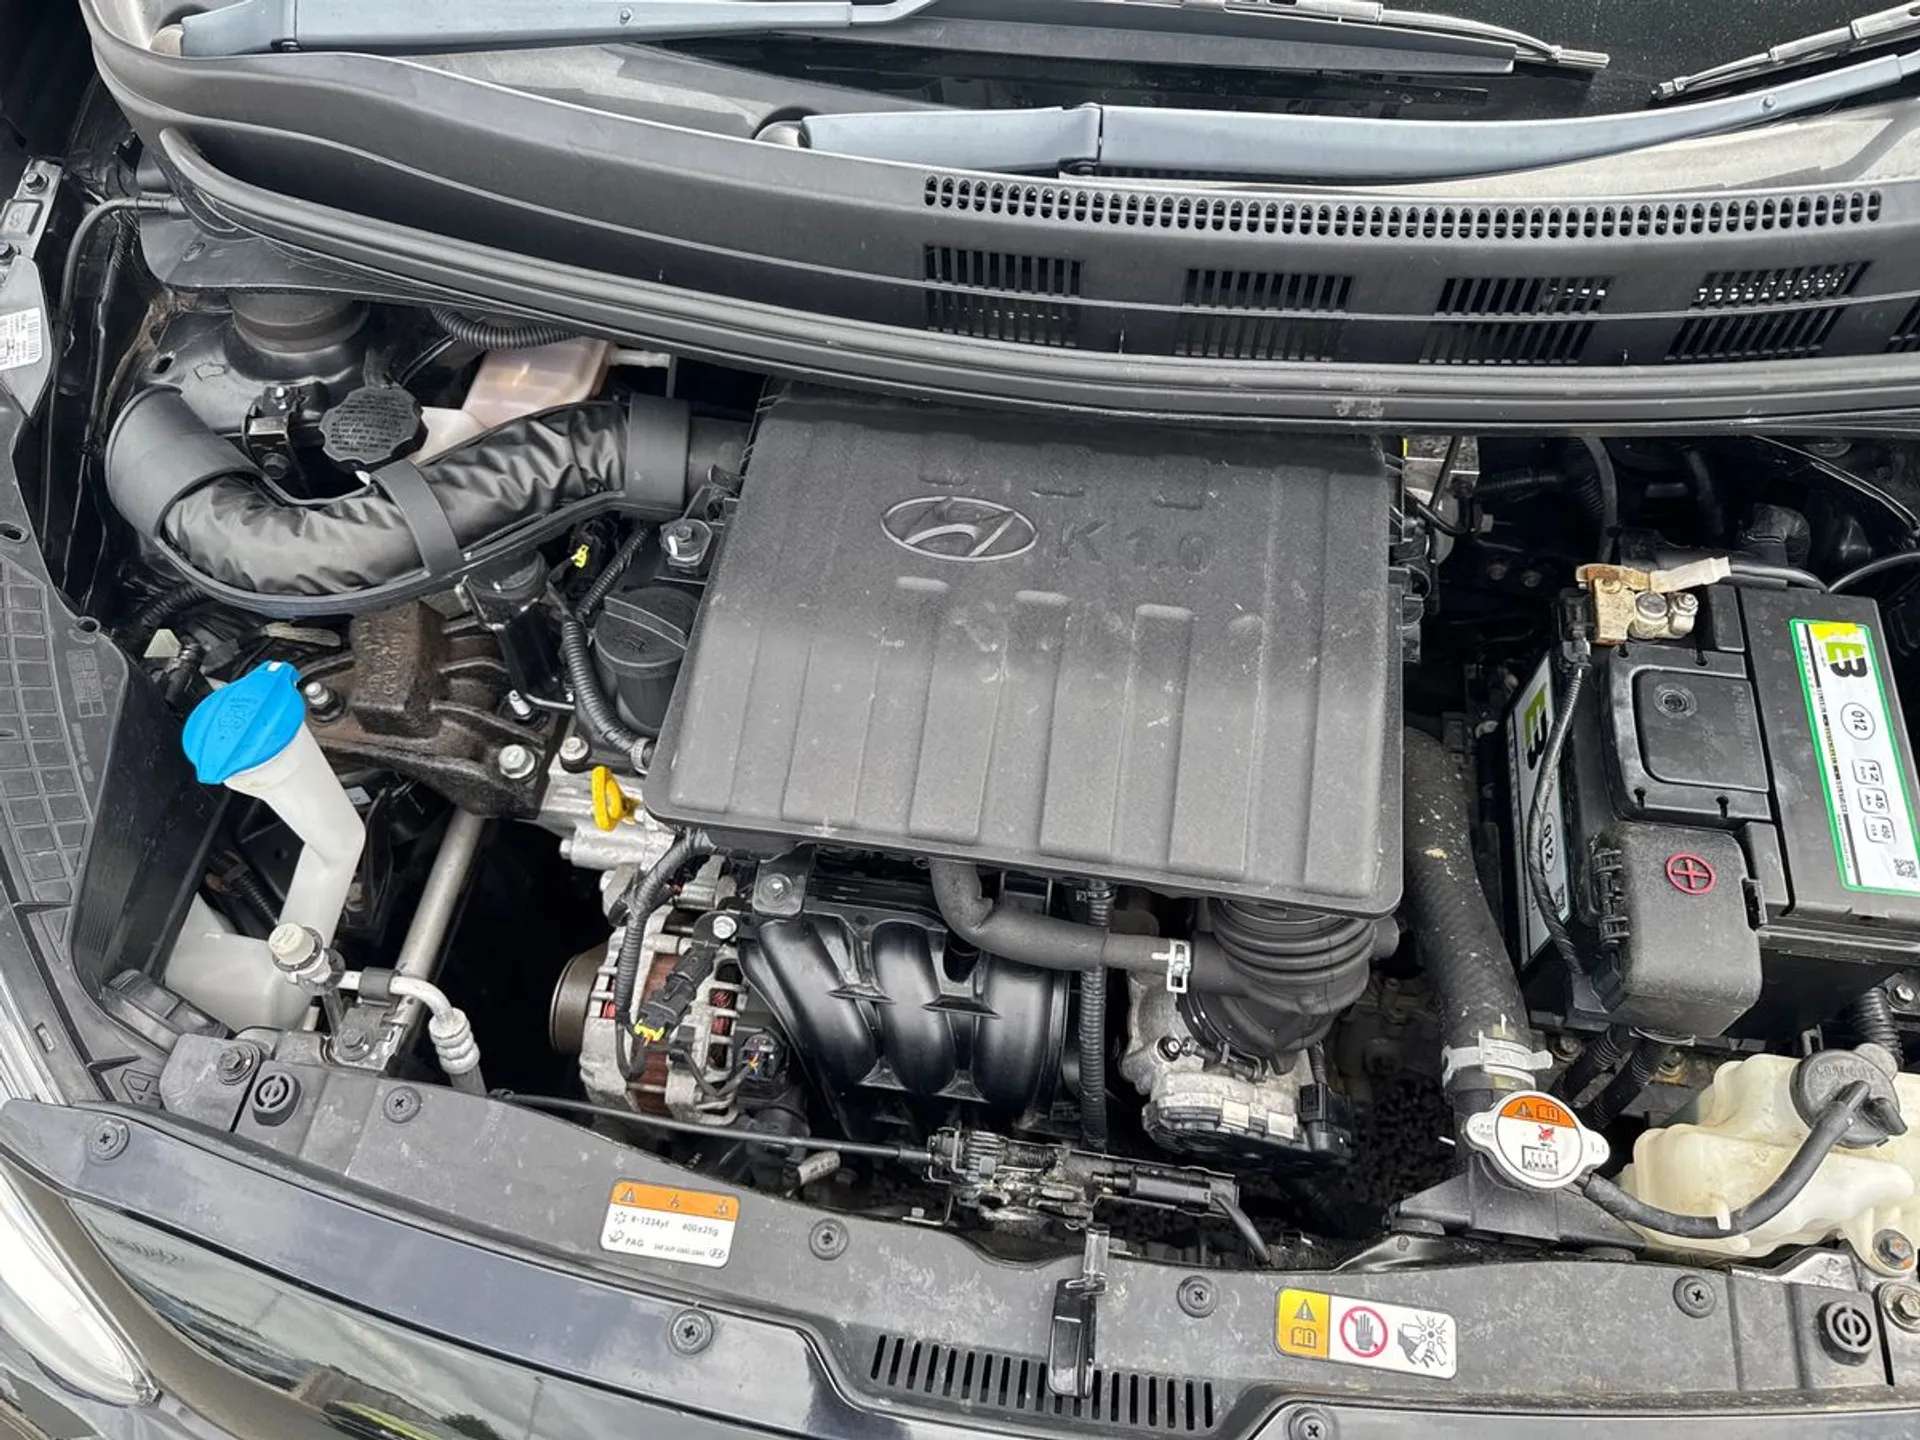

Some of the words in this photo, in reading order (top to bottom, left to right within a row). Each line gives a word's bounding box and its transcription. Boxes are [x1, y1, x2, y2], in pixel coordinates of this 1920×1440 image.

[1851, 710, 1868, 731] 012
[1869, 766, 1879, 782] 12
[1875, 793, 1885, 810] 45
[1544, 824, 1553, 864] 012
[625, 1237, 644, 1248] PAG
